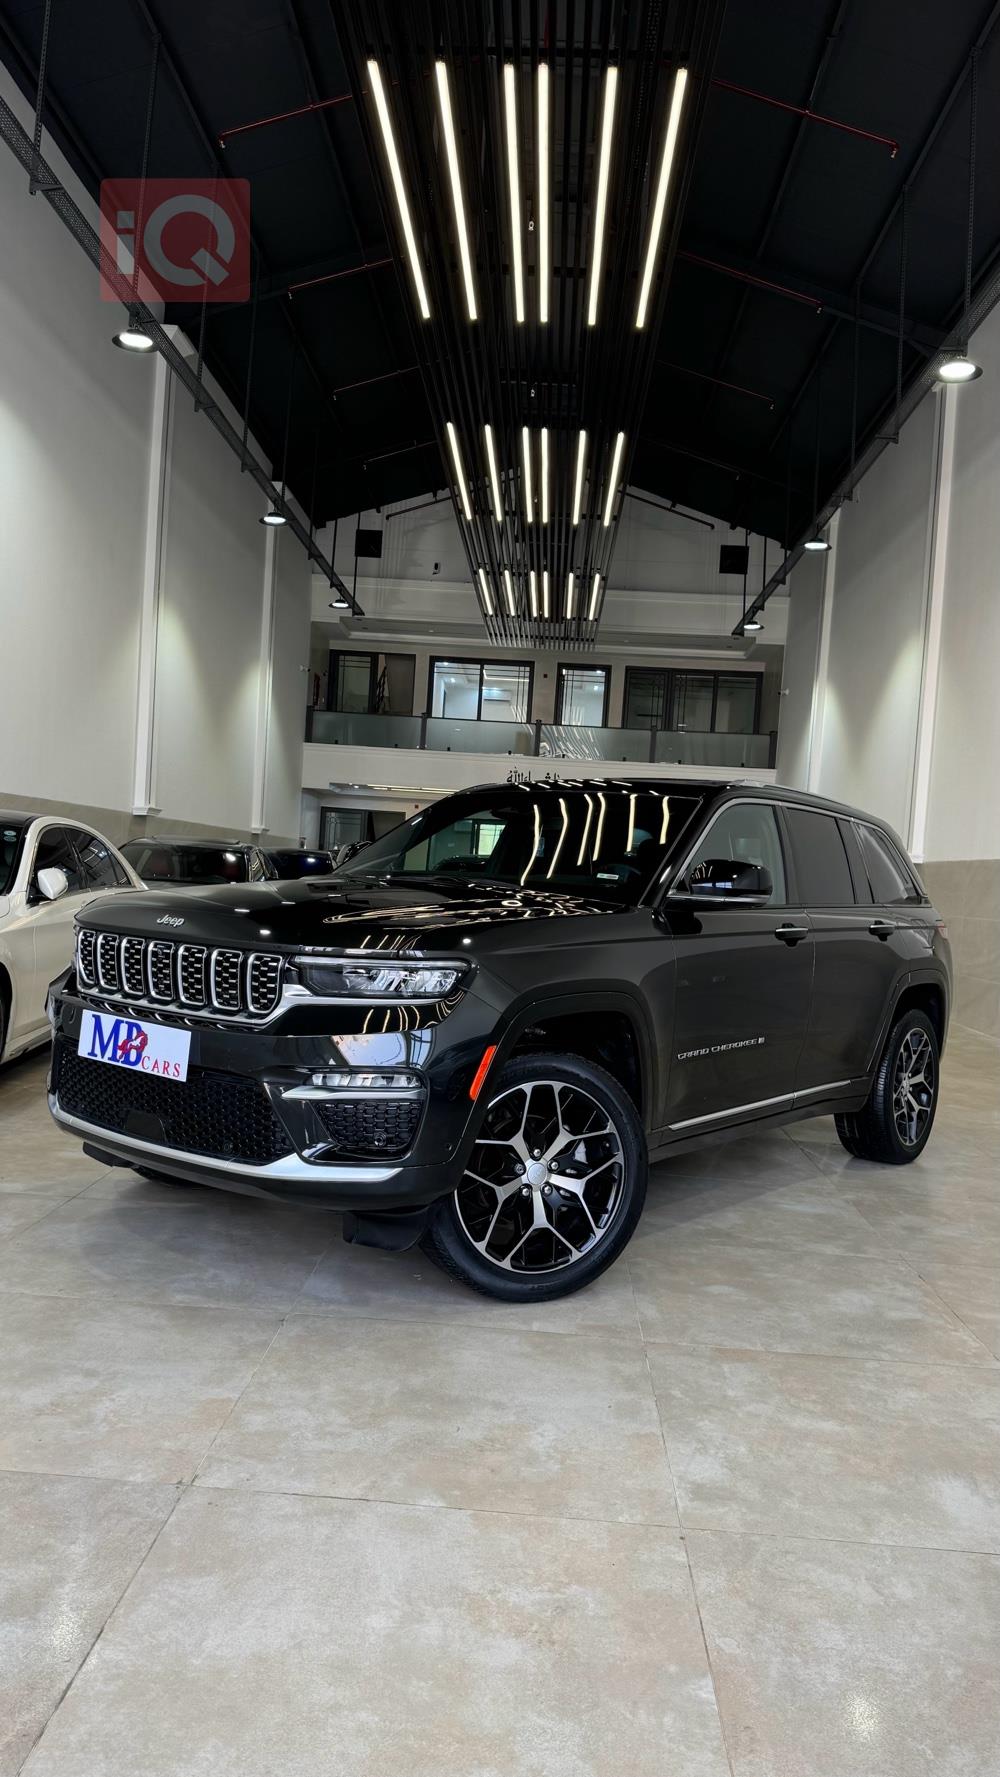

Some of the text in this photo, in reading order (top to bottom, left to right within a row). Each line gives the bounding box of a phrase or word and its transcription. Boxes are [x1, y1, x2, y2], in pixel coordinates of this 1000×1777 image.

[156, 914, 185, 928] Jeep
[87, 1014, 144, 1067] MB
[677, 1038, 758, 1060] GRAND CHEROKEE
[141, 1055, 181, 1078] CARS
